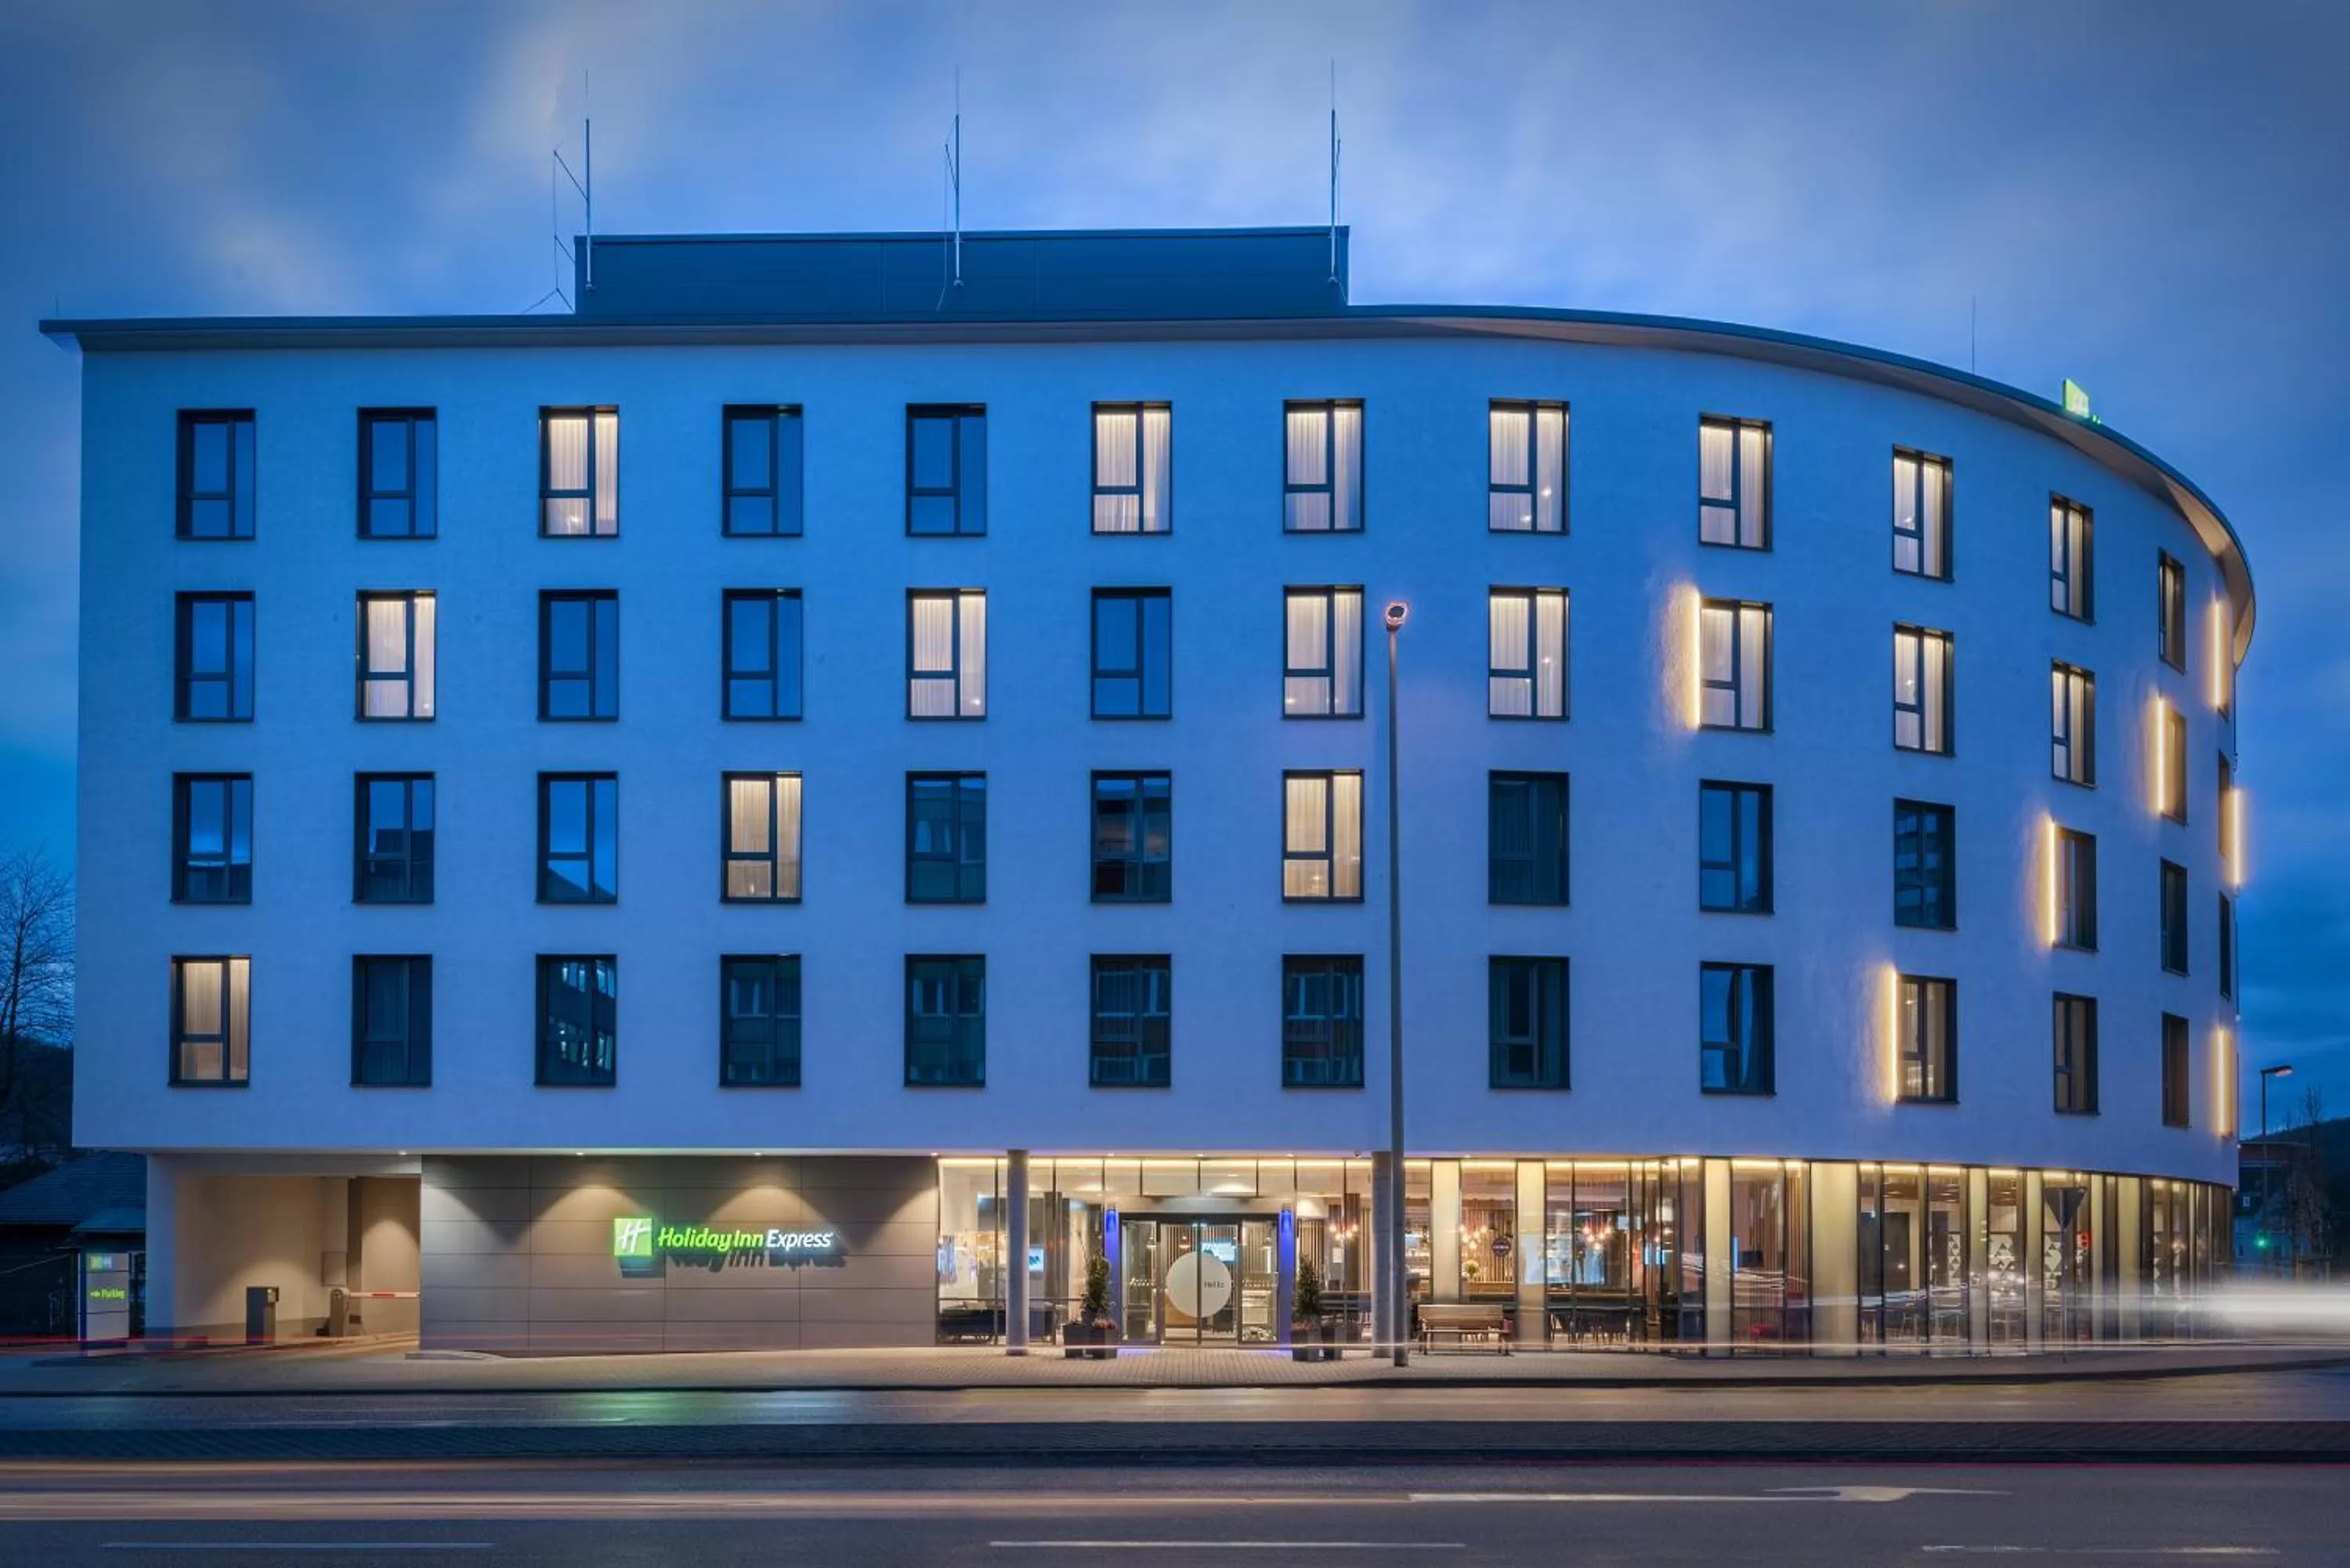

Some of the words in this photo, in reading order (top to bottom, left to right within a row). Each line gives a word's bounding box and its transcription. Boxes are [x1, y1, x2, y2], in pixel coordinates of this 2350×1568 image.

[658, 1228, 731, 1252] Holiday
[733, 1230, 764, 1248] Inn
[766, 1229, 833, 1251] Express
